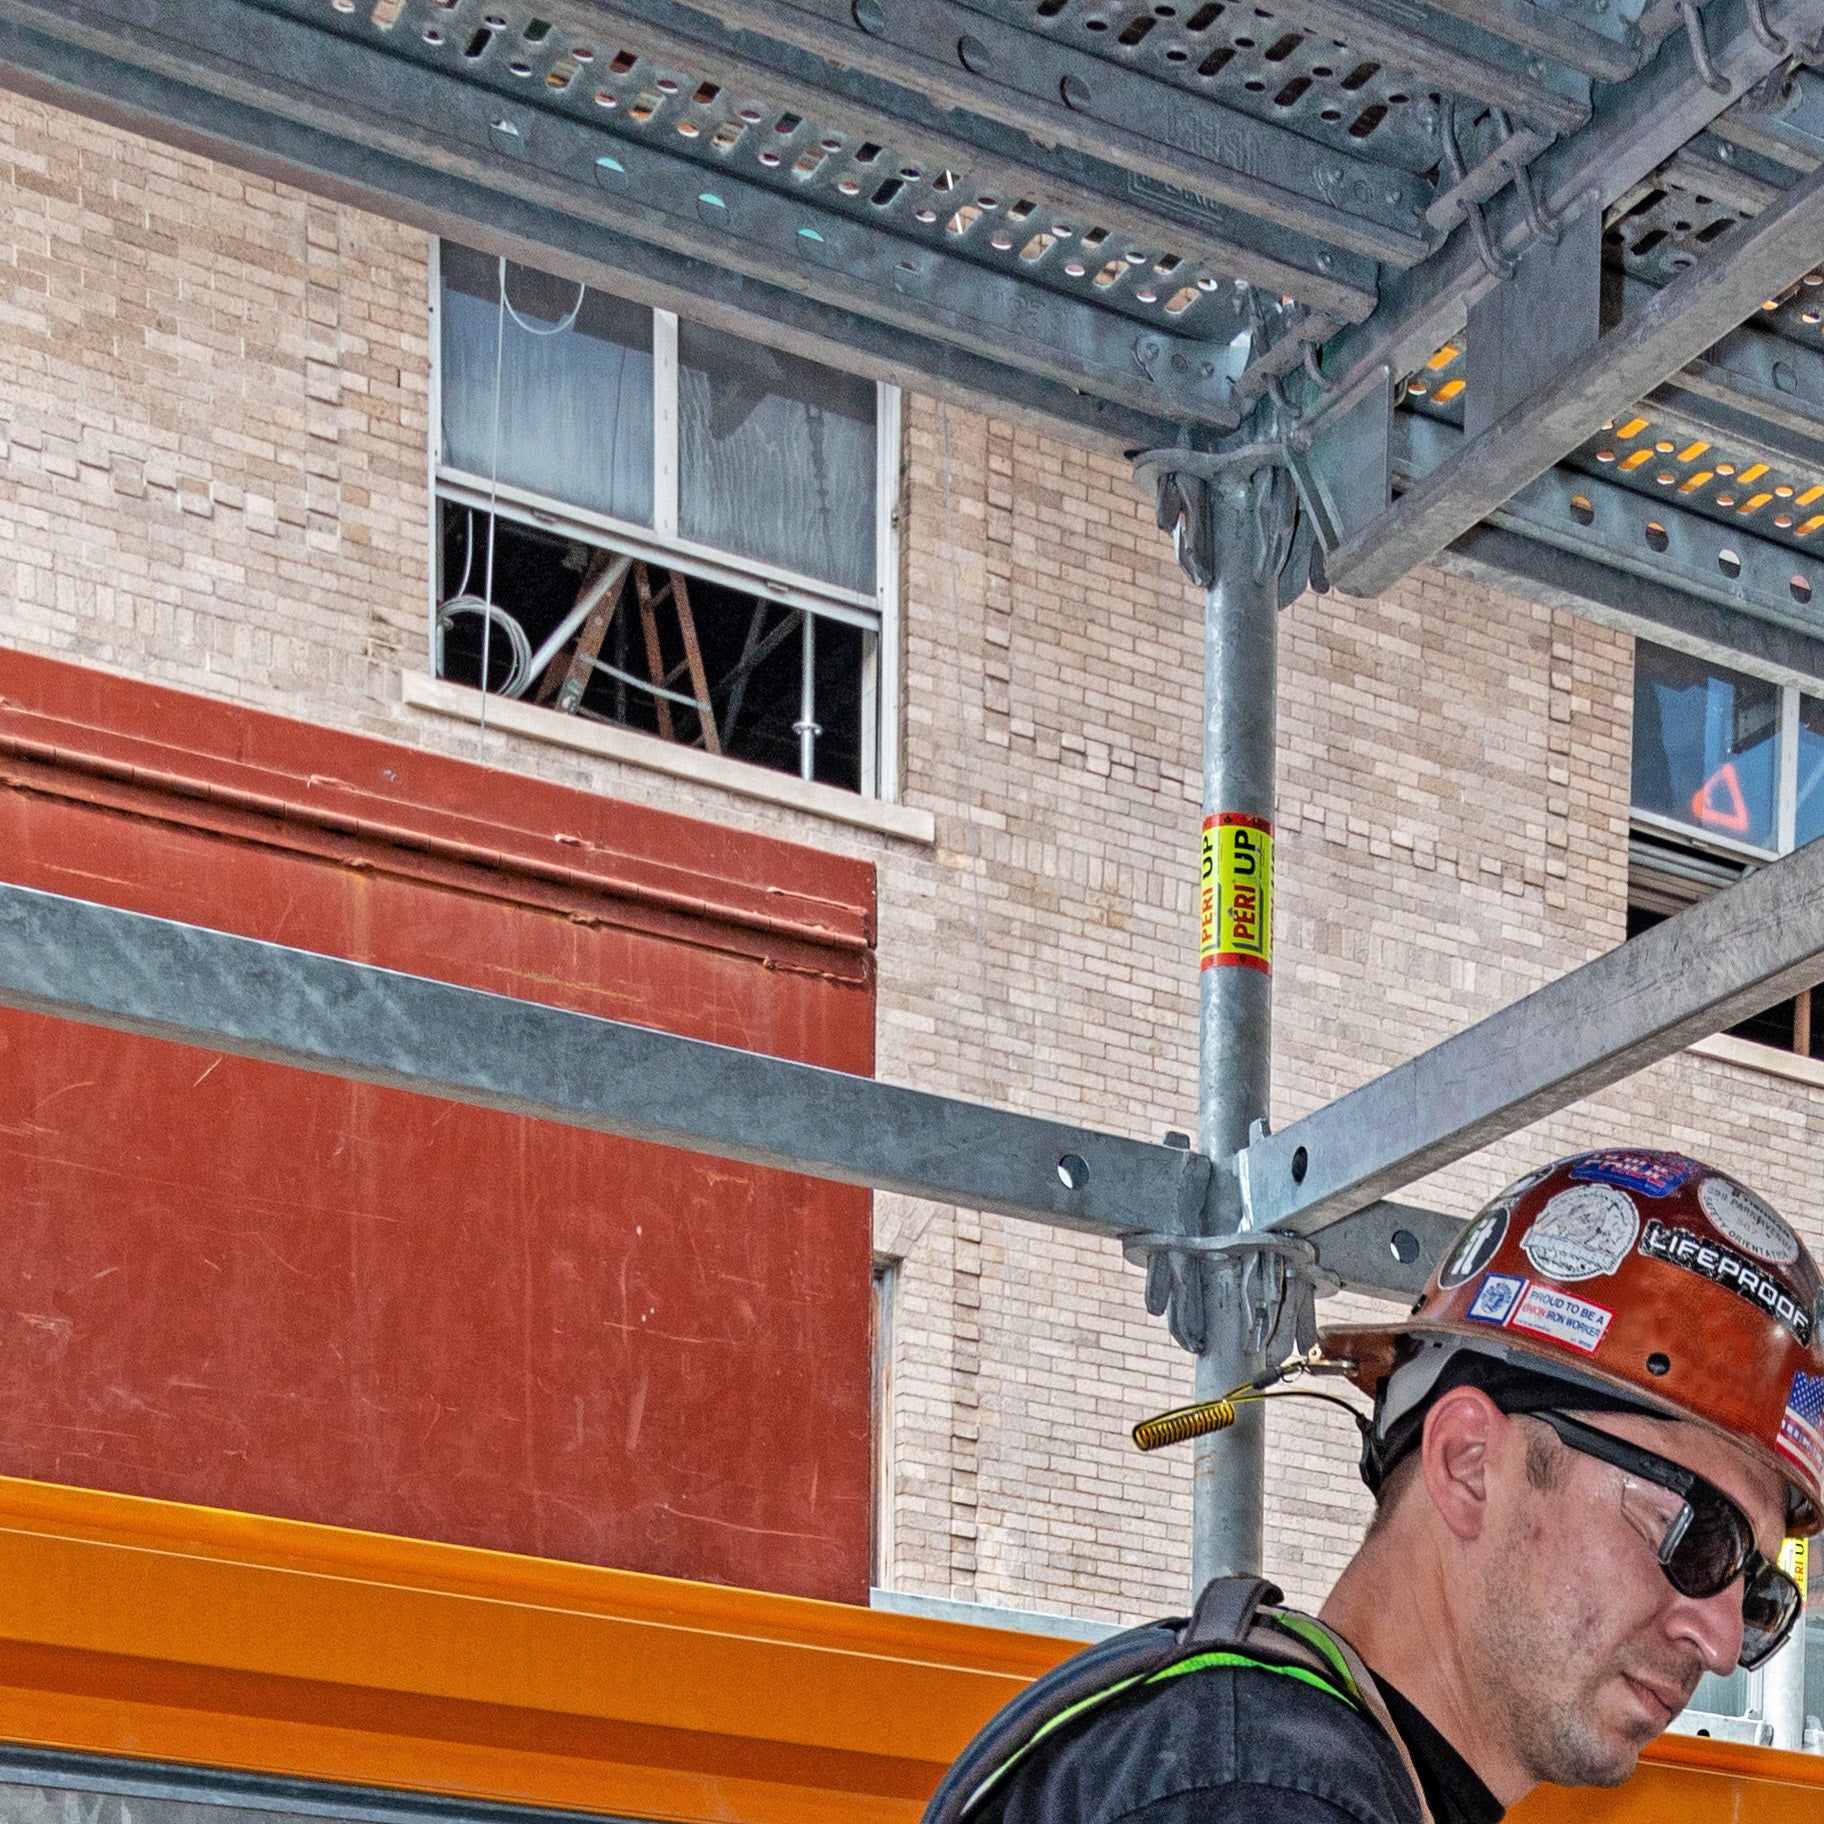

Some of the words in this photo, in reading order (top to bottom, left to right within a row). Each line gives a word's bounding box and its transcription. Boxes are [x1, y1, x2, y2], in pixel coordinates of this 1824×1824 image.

[1202, 835, 1214, 879] UP
[1234, 829, 1256, 874] UP
[1202, 888, 1214, 943] PERI
[1233, 885, 1256, 941] PERI
[1650, 1229, 1809, 1328] LIFEPROOF
[1529, 1290, 1565, 1309] PROUD
[1566, 1301, 1580, 1314] TO
[1580, 1306, 1595, 1321] BE
[1595, 1315, 1605, 1326] A
[1545, 1310, 1565, 1325] IRON
[1566, 1317, 1602, 1337] WORKER
